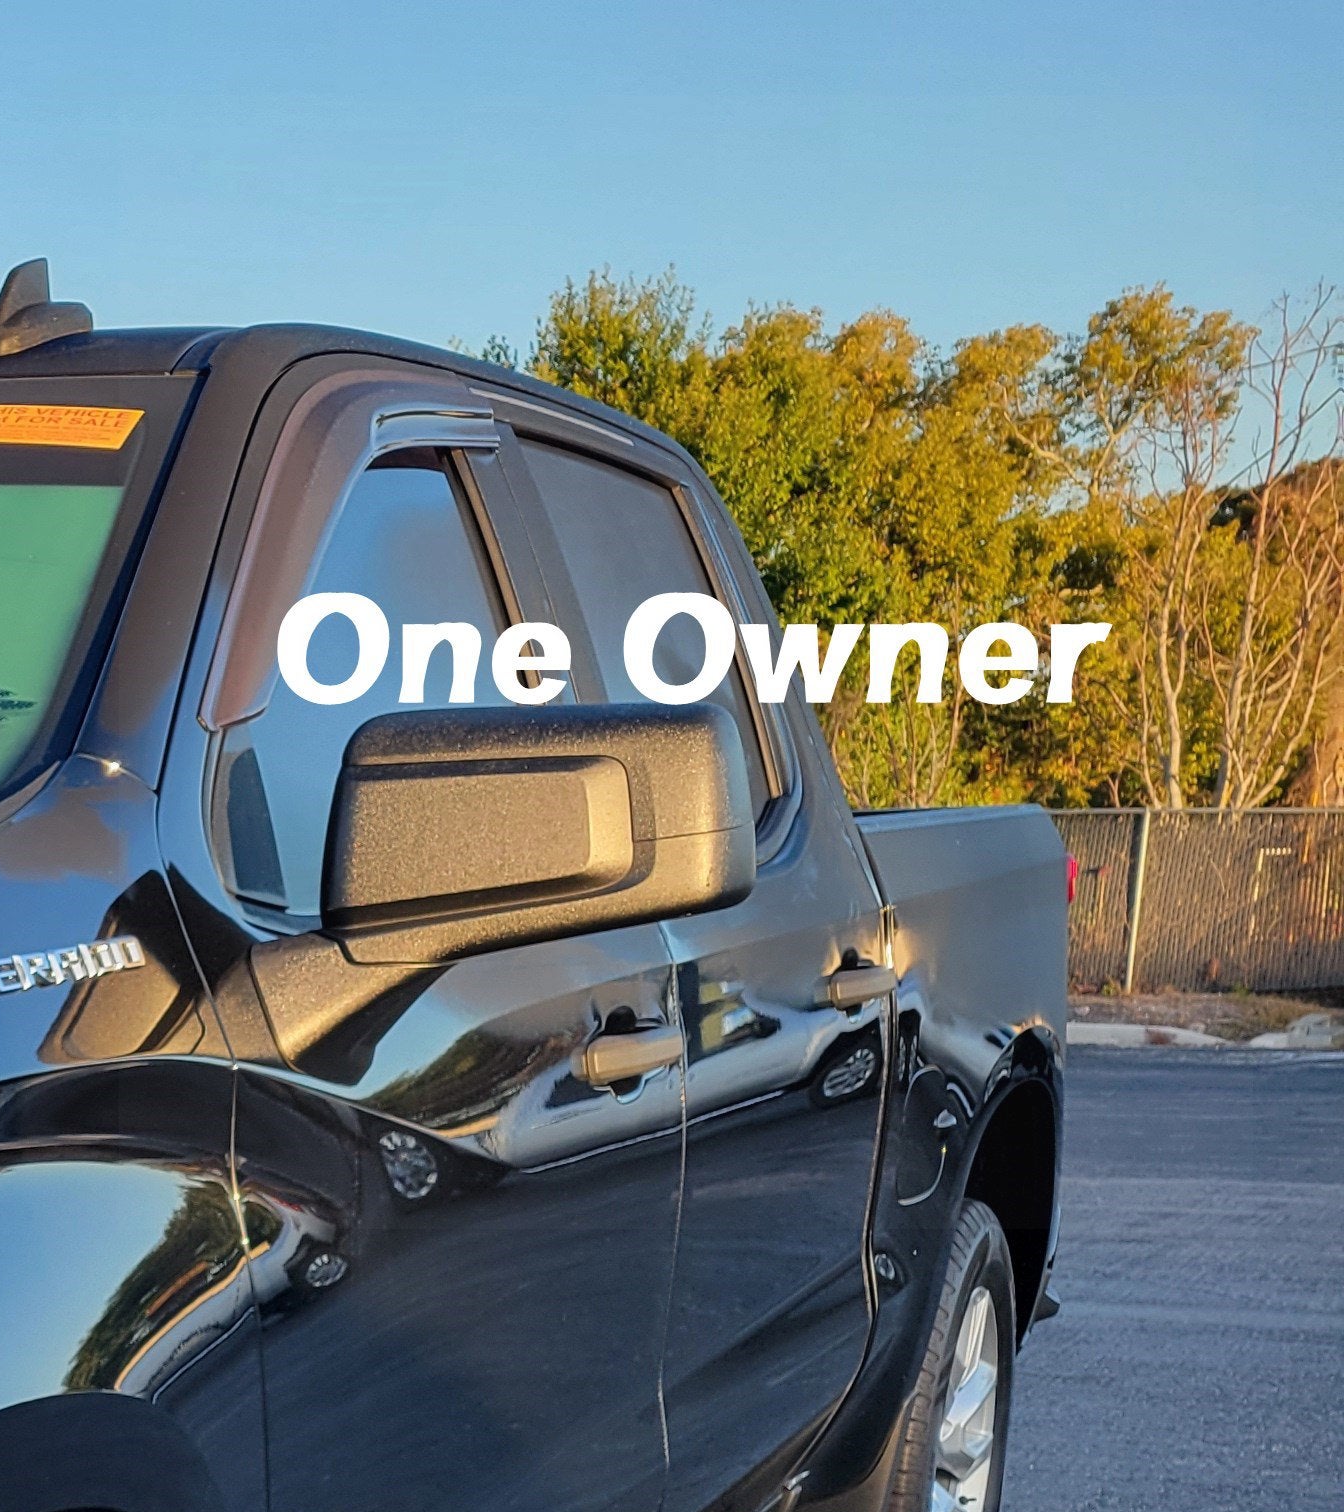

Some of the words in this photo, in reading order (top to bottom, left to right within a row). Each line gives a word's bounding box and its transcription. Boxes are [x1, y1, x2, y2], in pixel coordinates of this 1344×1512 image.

[37, 407, 131, 419] VEHICLE
[14, 415, 64, 425] FOR
[68, 417, 129, 428] SALE
